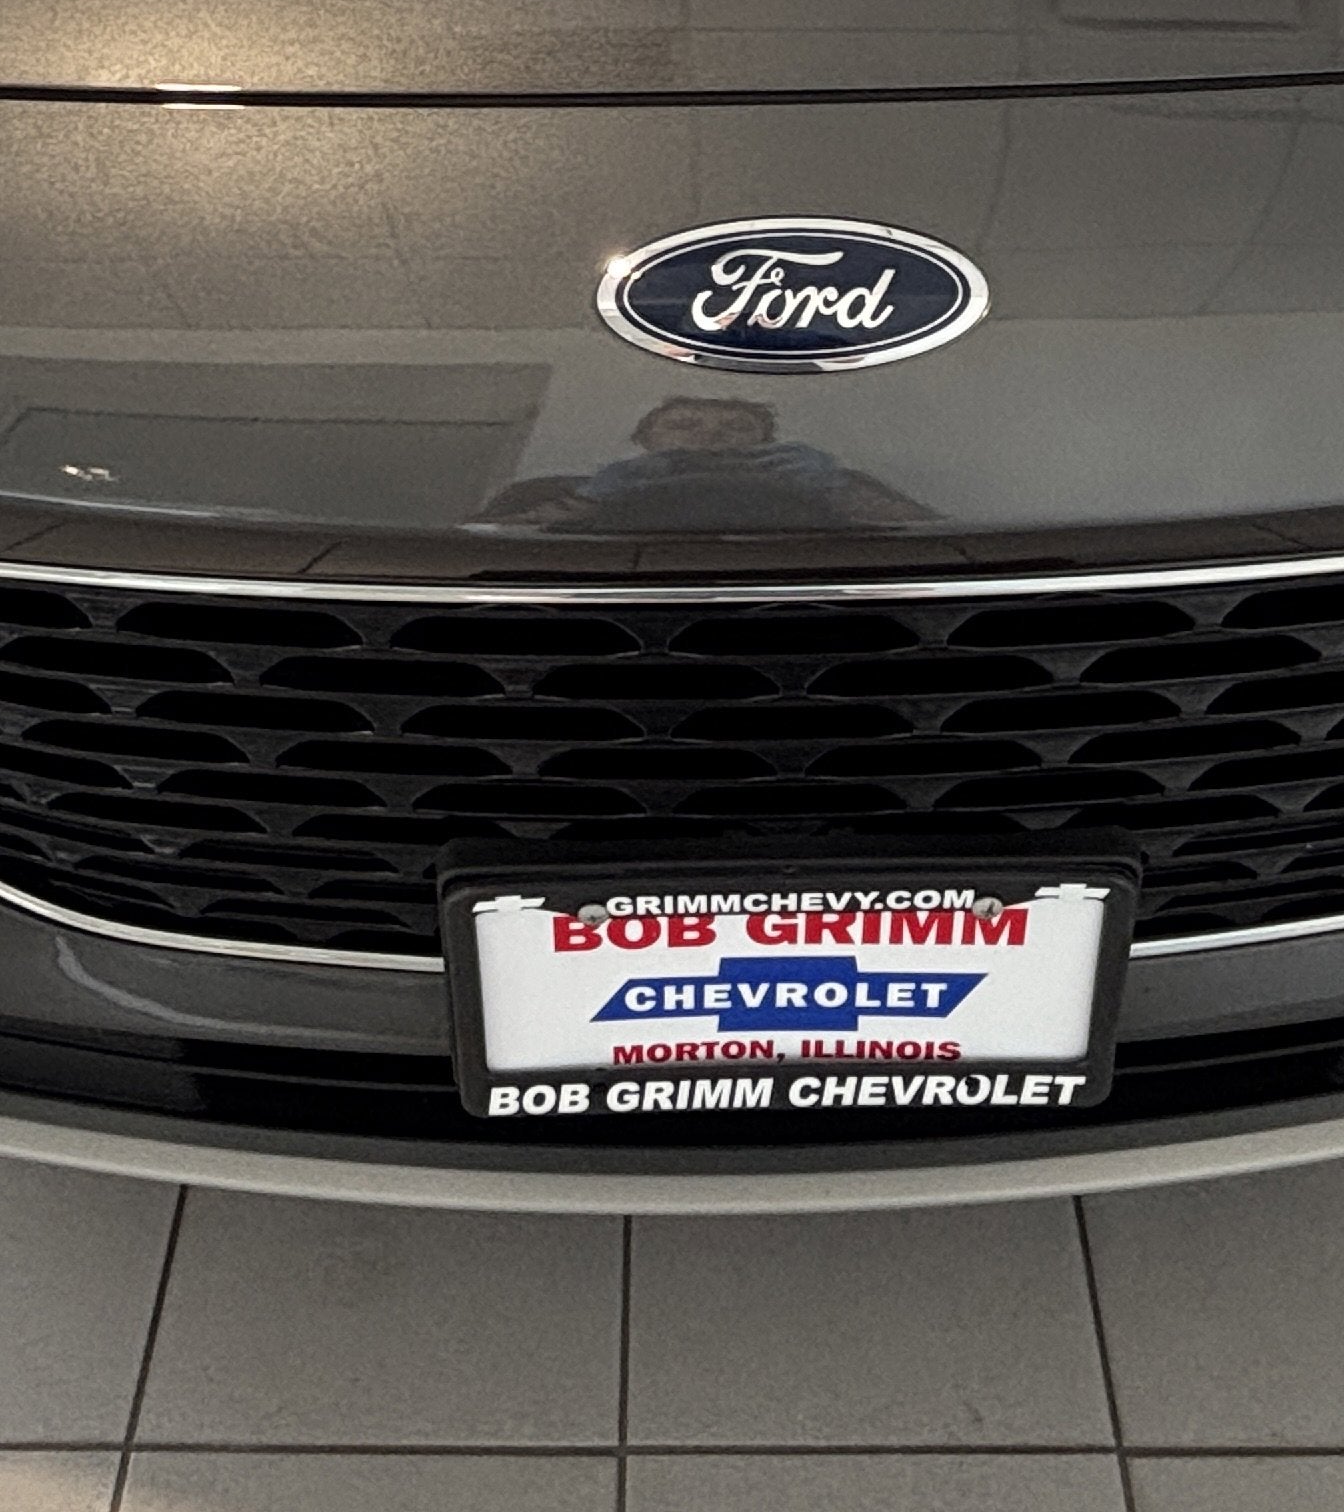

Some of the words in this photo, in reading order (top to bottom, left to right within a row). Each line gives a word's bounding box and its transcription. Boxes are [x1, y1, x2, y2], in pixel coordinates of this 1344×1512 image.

[691, 249, 896, 331] Ford
[606, 889, 976, 916] GRIMMCHEVY.COM
[553, 913, 717, 953] BOB
[746, 908, 1030, 946] GRIMM
[624, 982, 949, 1011] CHEVROLET
[613, 1040, 785, 1065] MORTON,
[801, 1040, 962, 1061] ILLINOIS
[488, 1084, 590, 1116] BOB
[606, 1077, 774, 1113] GRIMM
[788, 1074, 1087, 1106] CHEVROLET
